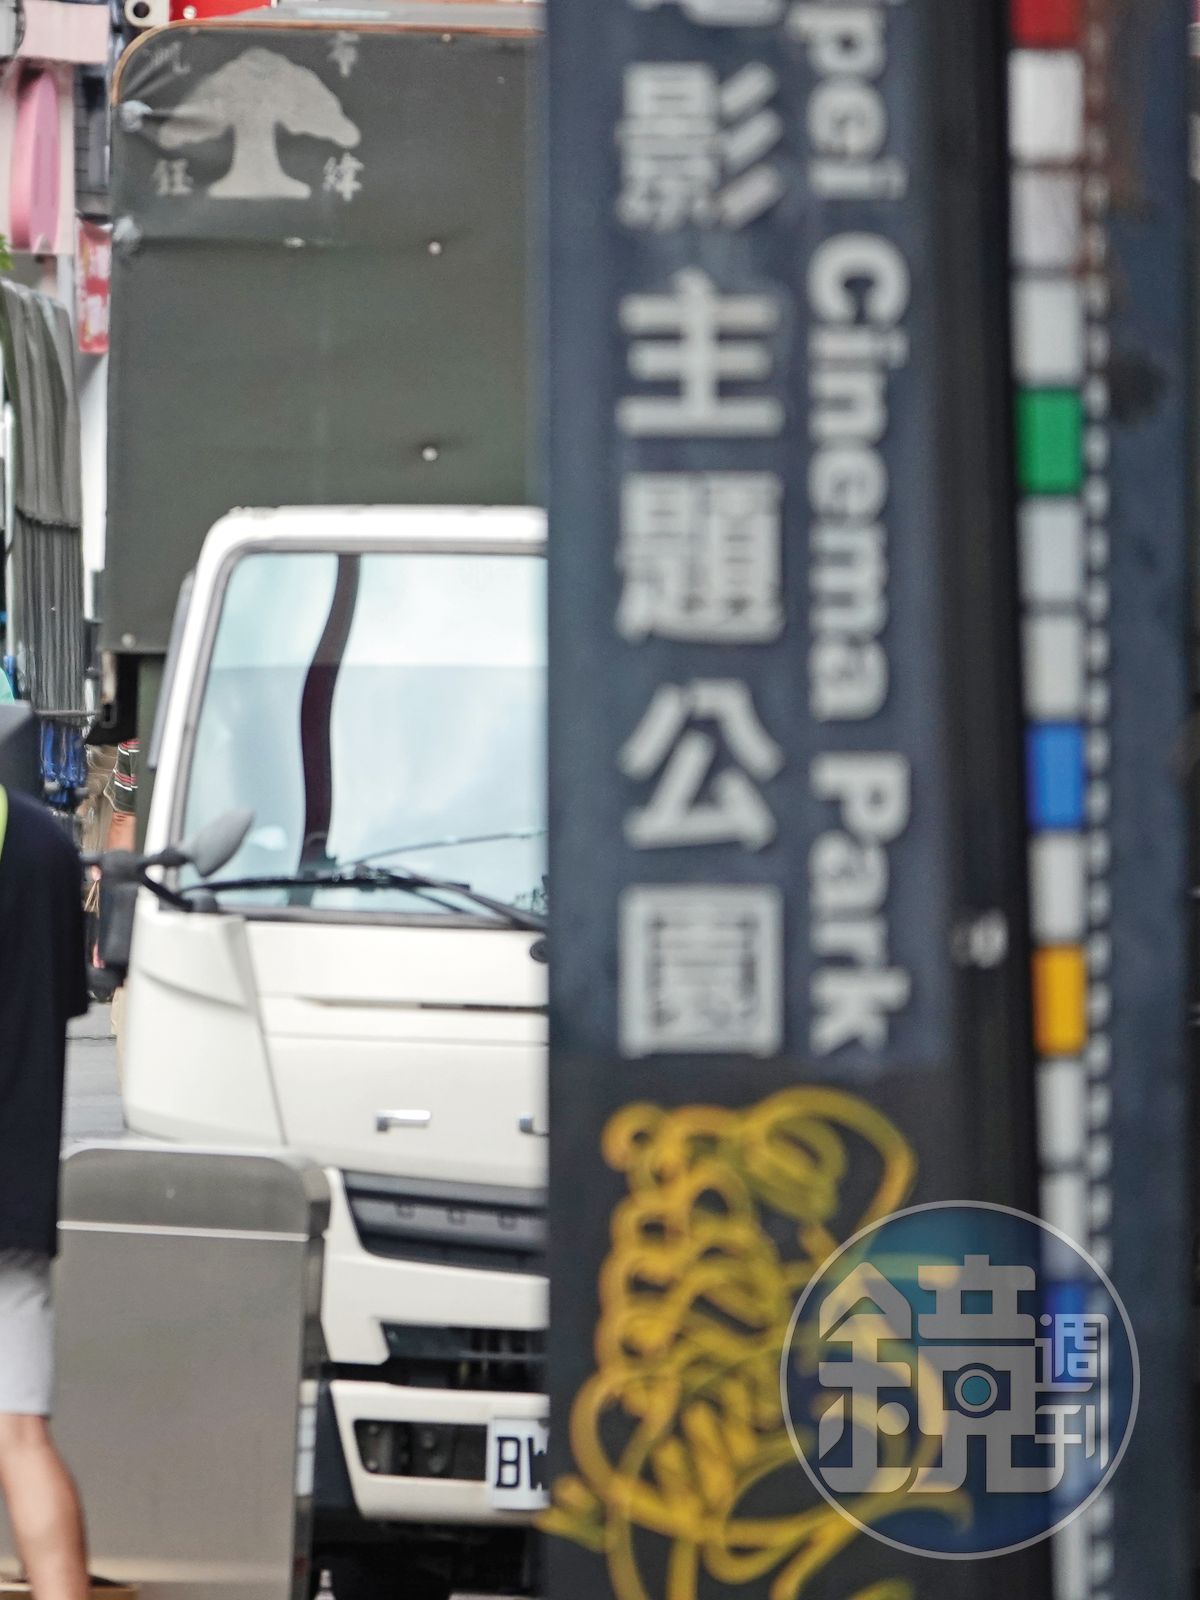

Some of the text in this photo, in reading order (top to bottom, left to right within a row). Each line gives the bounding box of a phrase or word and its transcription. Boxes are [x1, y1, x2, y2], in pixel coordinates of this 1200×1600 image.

[614, 0, 786, 1058] 影主題公園
[787, 0, 911, 1056] pei Cinema Park
